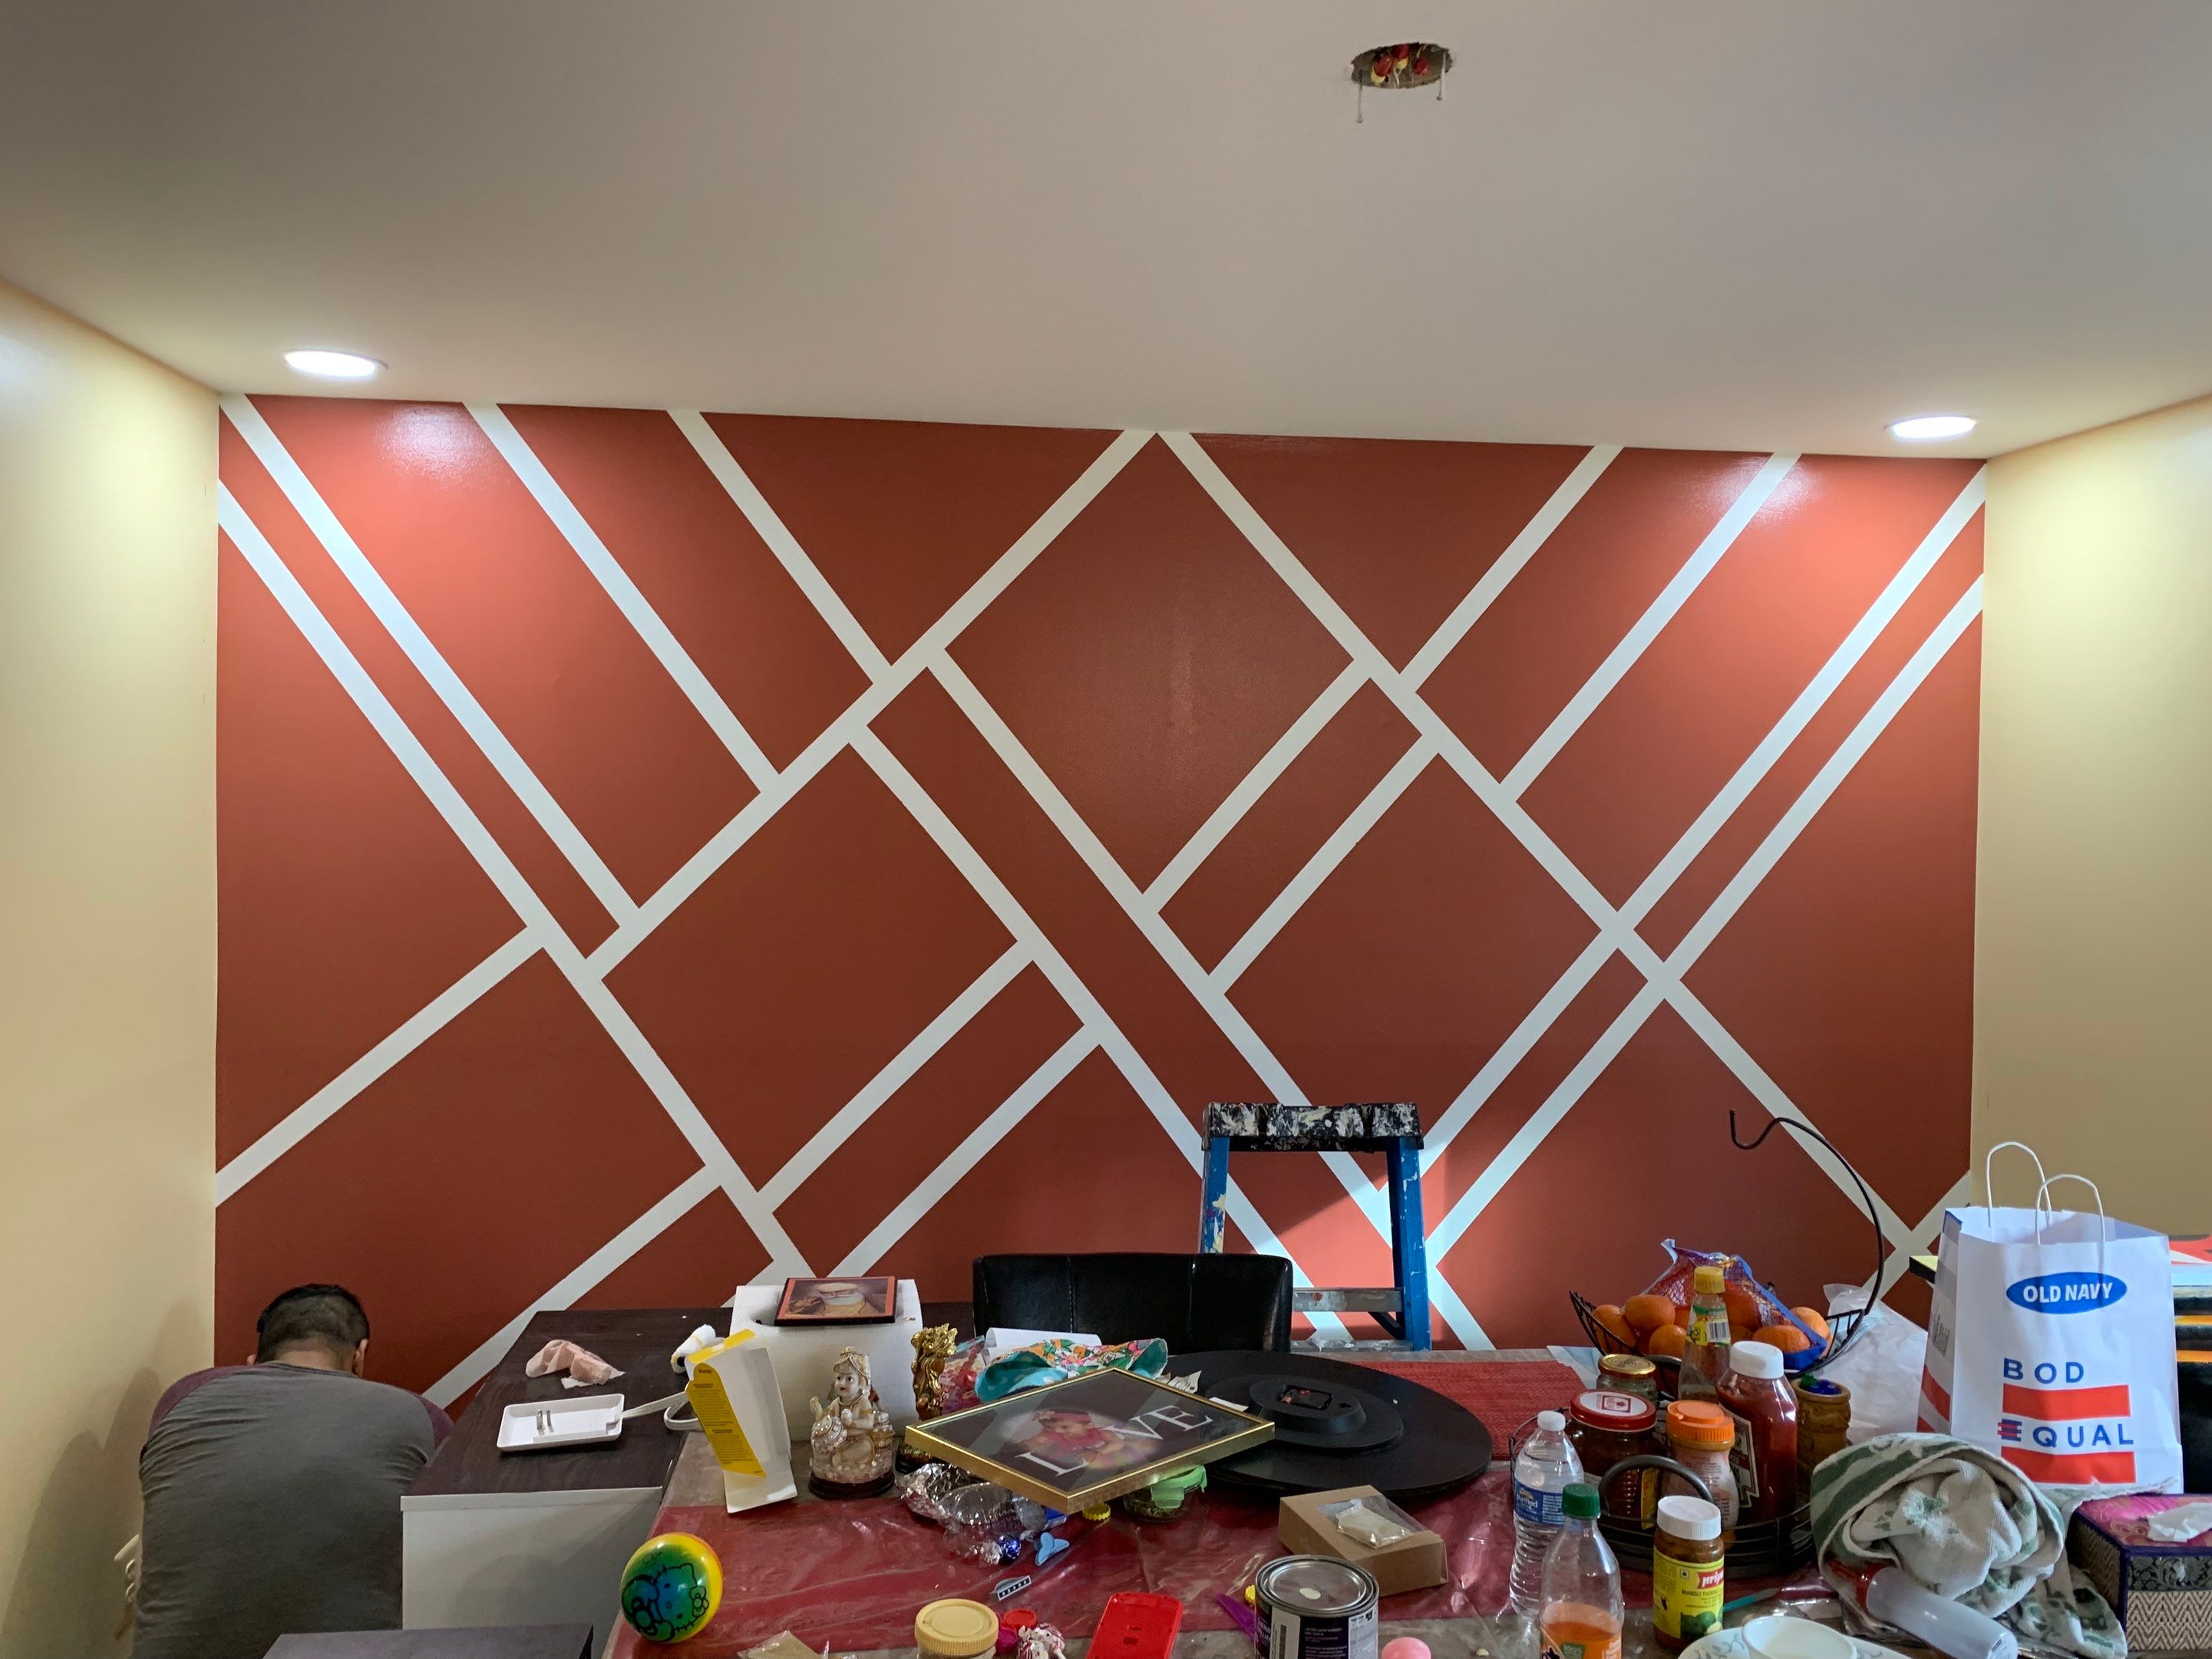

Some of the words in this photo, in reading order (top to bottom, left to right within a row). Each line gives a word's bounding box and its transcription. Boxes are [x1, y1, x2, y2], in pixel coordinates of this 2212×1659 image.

[2023, 1285, 2061, 1303] OLD
[2065, 1282, 2114, 1301] NAVY
[2003, 1357, 2085, 1384] BOD
[1997, 1418, 2134, 1448] EQUAL
